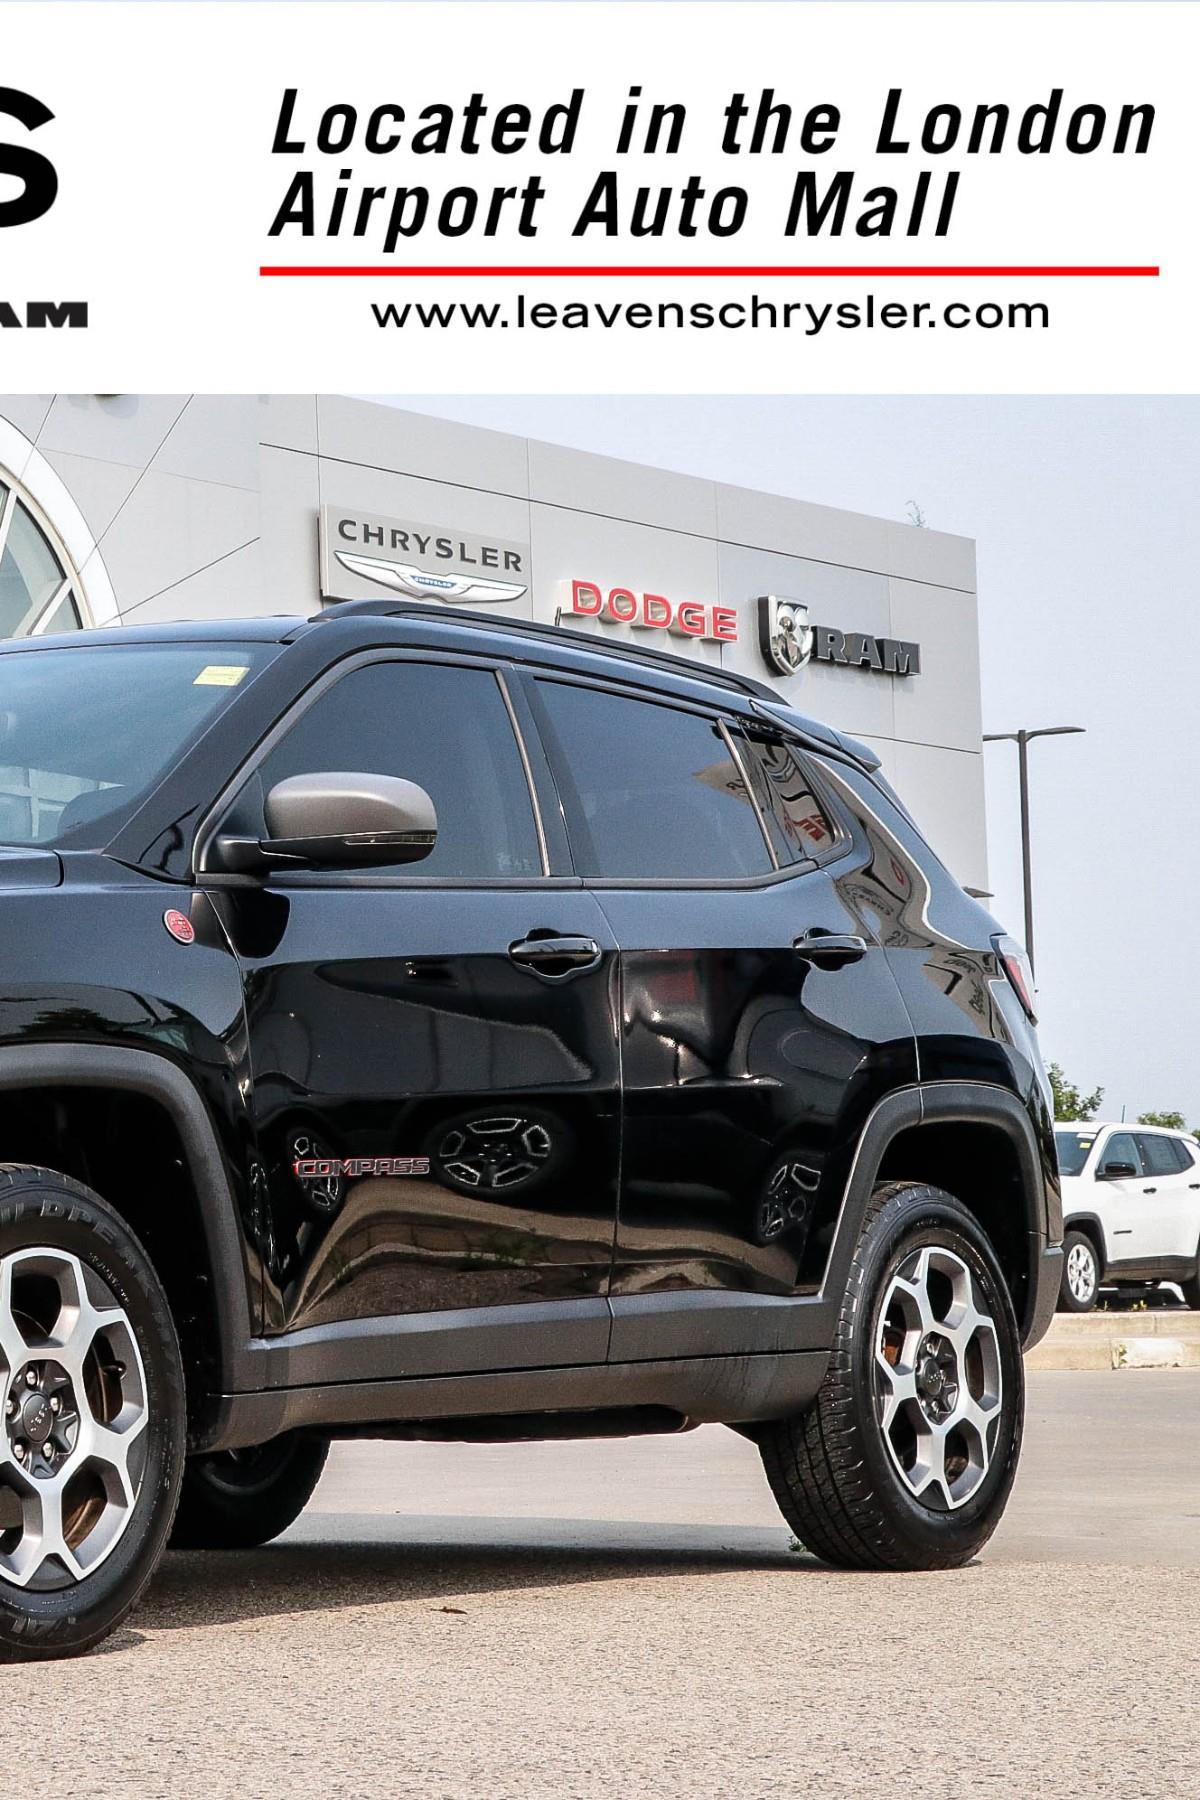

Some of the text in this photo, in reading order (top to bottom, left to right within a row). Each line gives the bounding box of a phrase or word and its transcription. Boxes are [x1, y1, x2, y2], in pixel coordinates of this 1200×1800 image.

[338, 518, 522, 573] CHRYSLER
[571, 578, 739, 642] DODGE
[811, 624, 921, 675] RAM
[293, 1157, 431, 1178] COMPASS
